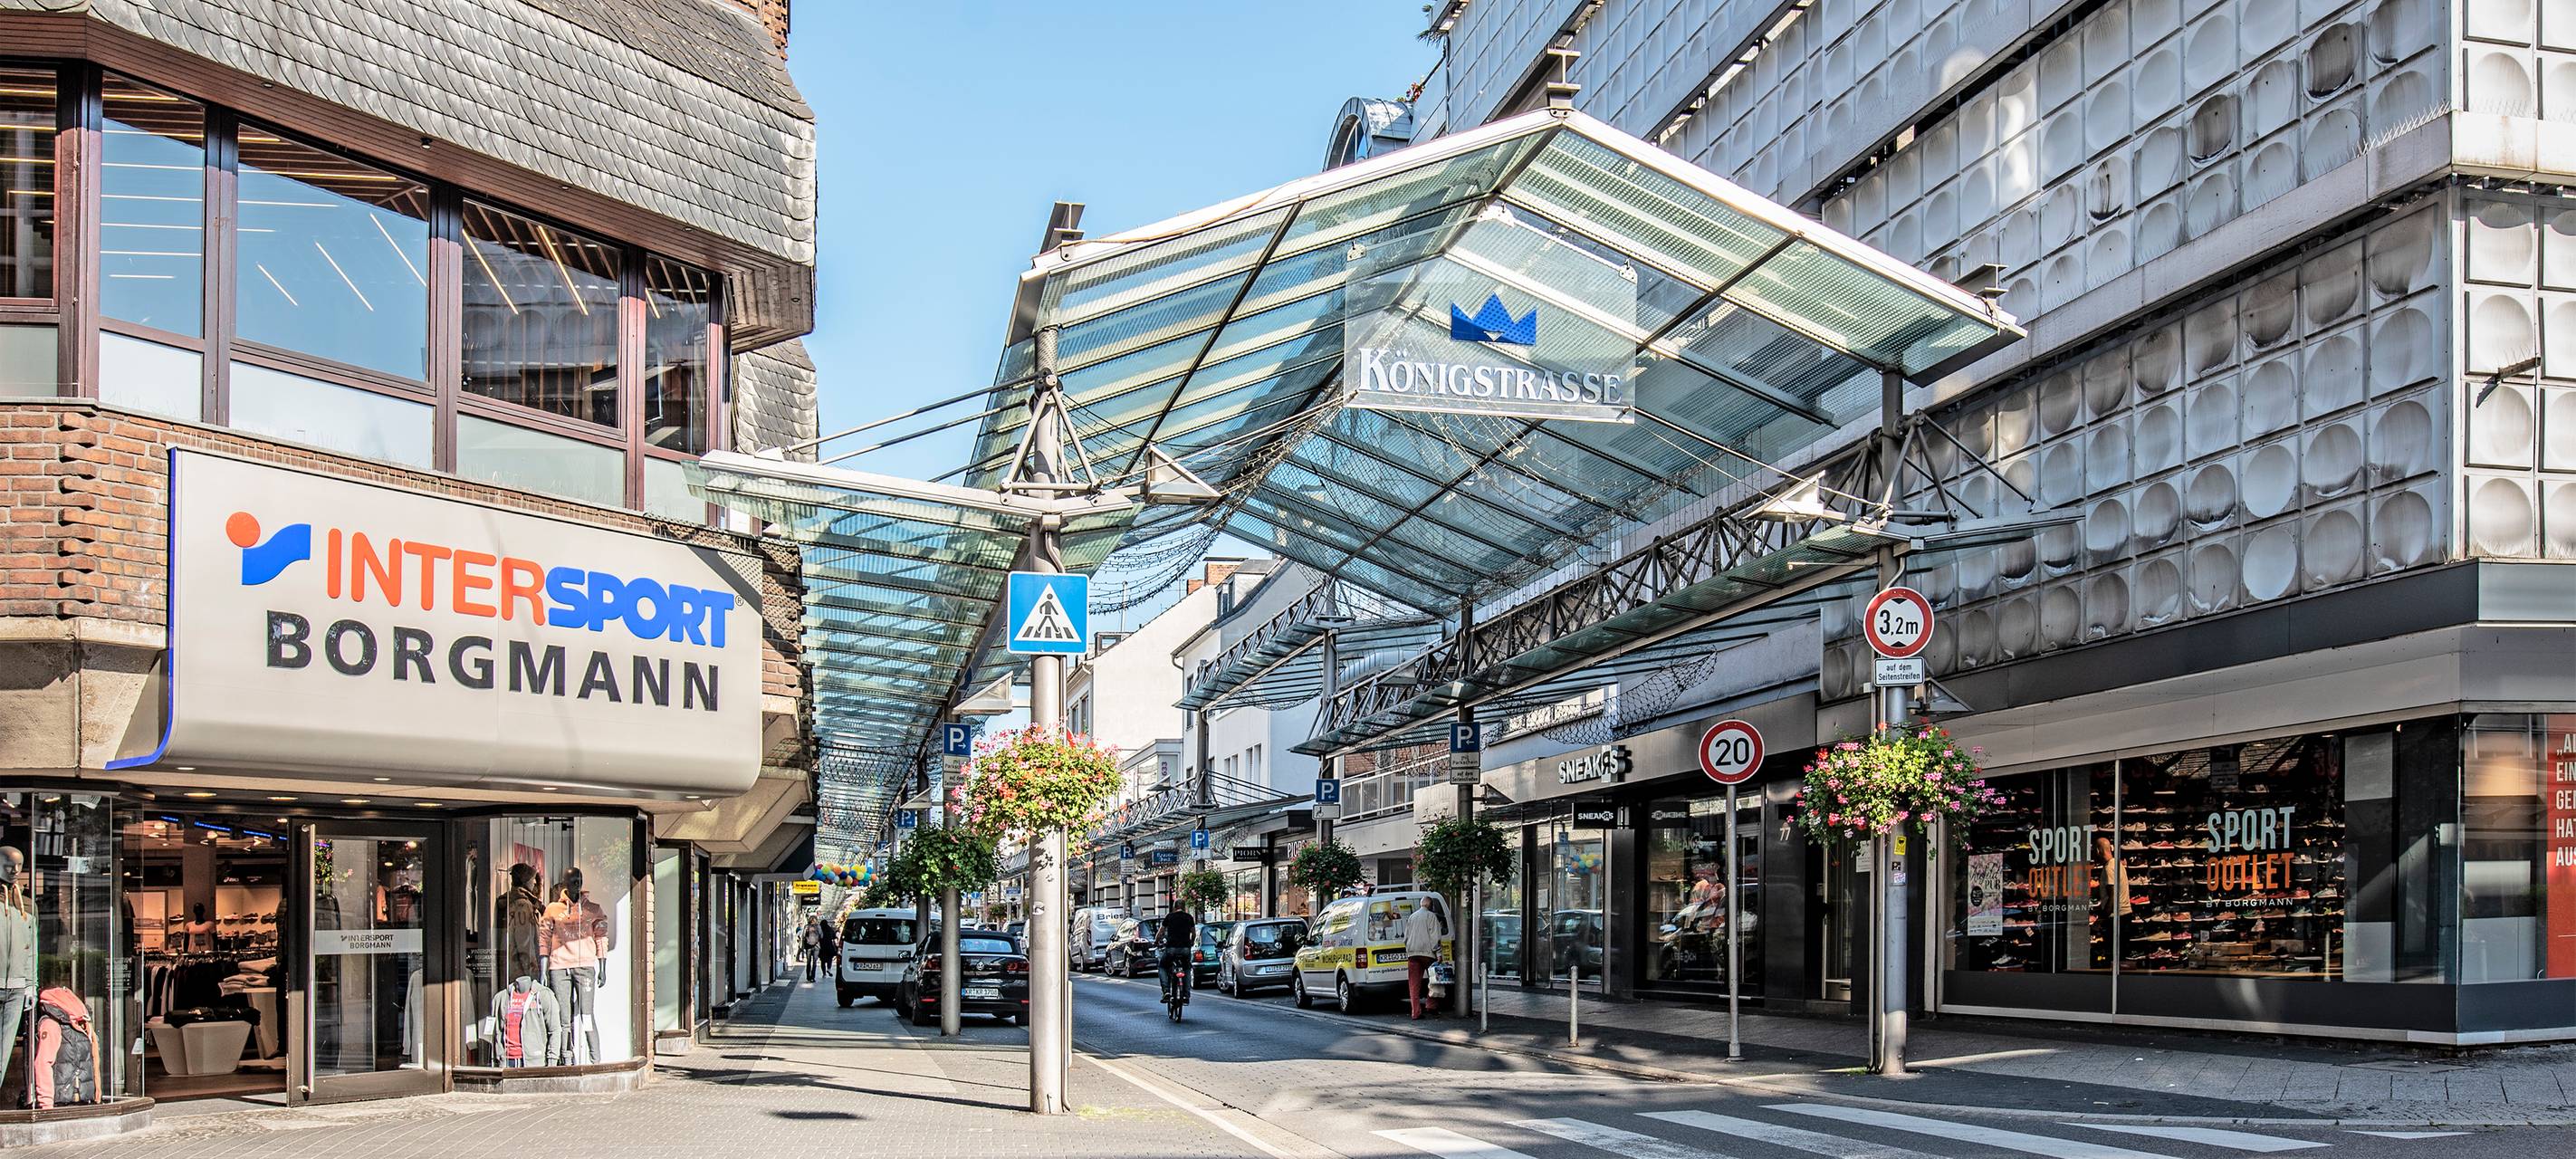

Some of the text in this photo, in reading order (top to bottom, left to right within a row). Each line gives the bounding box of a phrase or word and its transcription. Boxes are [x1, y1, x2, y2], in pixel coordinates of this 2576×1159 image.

[1358, 348, 1622, 406] KÖNIGSTRASSE
[327, 528, 734, 647] INTERSPORT
[266, 609, 719, 713] BORGMANN
[1878, 673, 1920, 681] Seitenstreifen
[949, 727, 965, 752] P
[1457, 725, 1473, 749] P
[1715, 737, 1749, 766] 20
[1321, 781, 1335, 800] P
[1195, 832, 1205, 847] P
[1779, 827, 1791, 841] 77
[2207, 806, 2296, 853] SPORT
[2028, 824, 2097, 865] SPORT
[2028, 863, 2095, 898] OUTLET
[2207, 852, 2294, 891] OUTLET
[2225, 898, 2294, 907] BORGMANN
